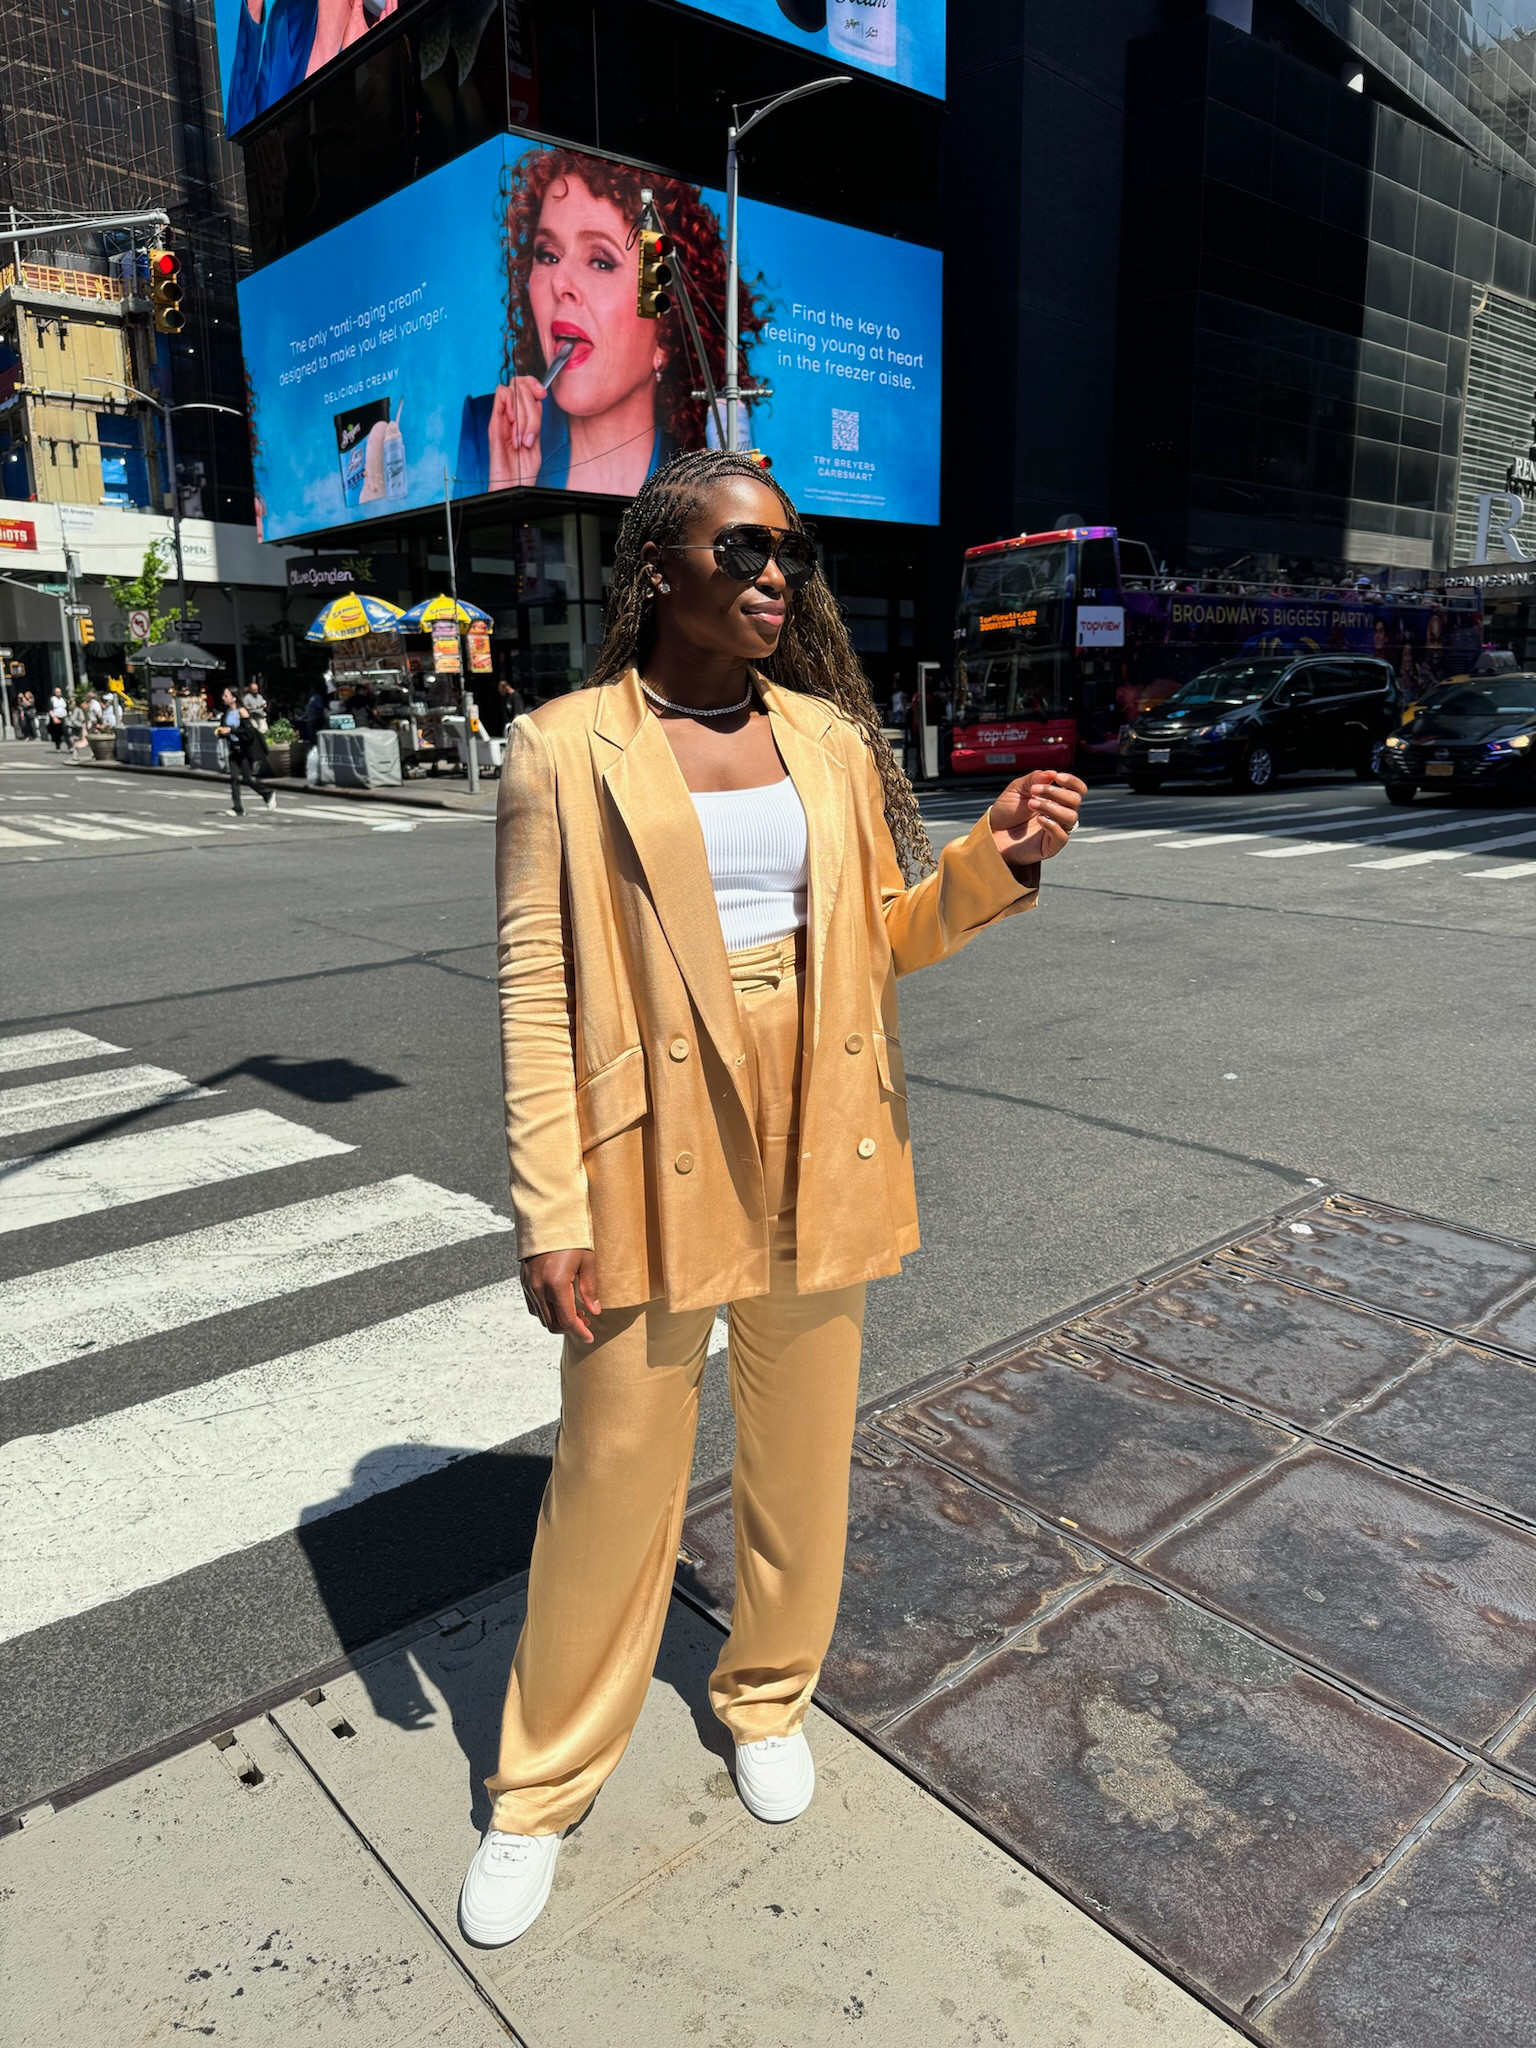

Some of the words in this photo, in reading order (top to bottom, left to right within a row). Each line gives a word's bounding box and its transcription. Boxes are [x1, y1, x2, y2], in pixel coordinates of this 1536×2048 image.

[792, 303, 826, 325] Find
[830, 311, 853, 330] the
[858, 318, 883, 340] key
[886, 324, 900, 340] to
[279, 357, 318, 386] designed
[318, 356, 328, 370] to
[330, 344, 356, 365] make
[359, 337, 377, 358] you
[379, 327, 398, 346] feel
[399, 307, 448, 337] younger.
[290, 341, 306, 356] The
[308, 331, 327, 349] only
[764, 323, 816, 351] feeling
[821, 338, 866, 361] young
[869, 346, 884, 361] at
[888, 348, 924, 368] heart
[777, 350, 792, 367] in
[797, 354, 821, 373] the
[825, 359, 876, 382] freezer
[878, 371, 916, 390] aisle.
[324, 381, 364, 404] DELICIOUS
[366, 367, 399, 389] CREAMY
[813, 455, 831, 466] TRY
[833, 457, 876, 471] BREYERS
[817, 468, 873, 481] CARBSMART
[183, 544, 207, 555] OPEN
[290, 569, 309, 585] Olive
[309, 567, 355, 587] Garden
[1083, 588, 1096, 599] 374
[980, 619, 1016, 632] DOWNTOWN
[1017, 616, 1037, 627] TOUR
[1273, 608, 1329, 627] BIGGEST
[1332, 611, 1374, 629] PARTY!
